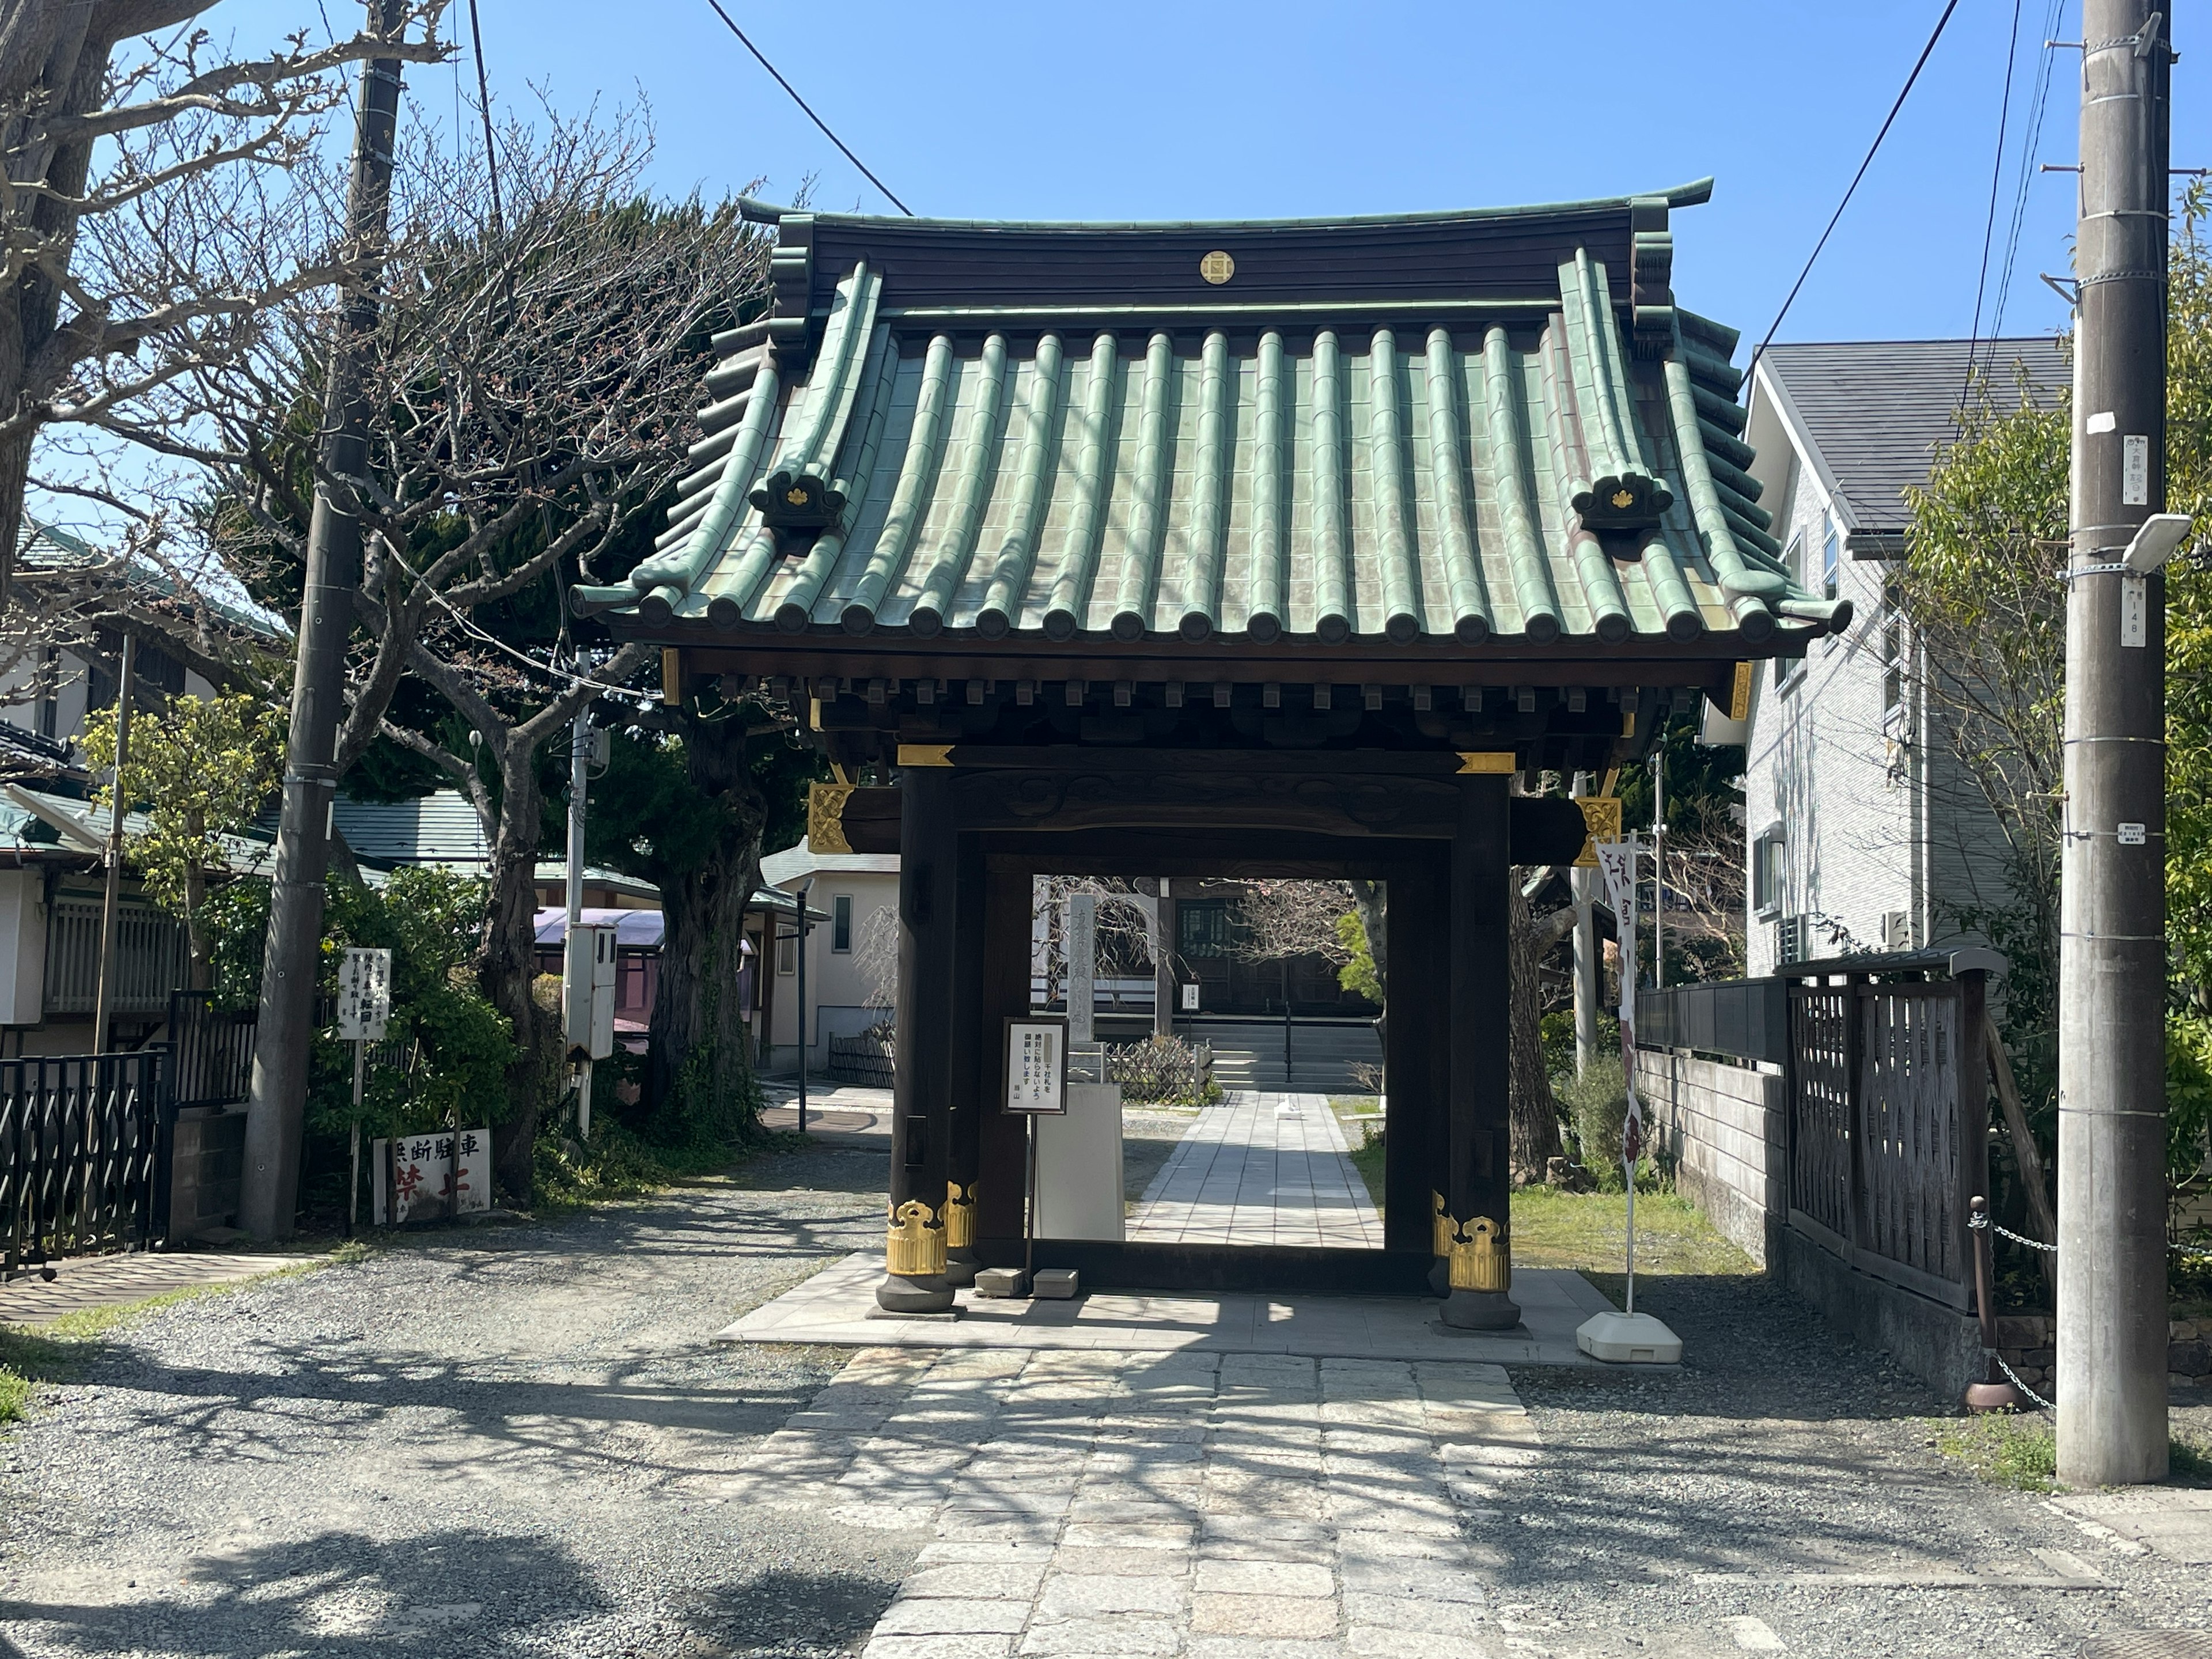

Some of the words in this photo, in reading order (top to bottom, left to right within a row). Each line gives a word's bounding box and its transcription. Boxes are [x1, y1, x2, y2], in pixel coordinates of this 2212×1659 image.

[1023, 1034, 1031, 1085] 御願い致します
[1033, 1034, 1041, 1100] 絶対に貼らないよう
